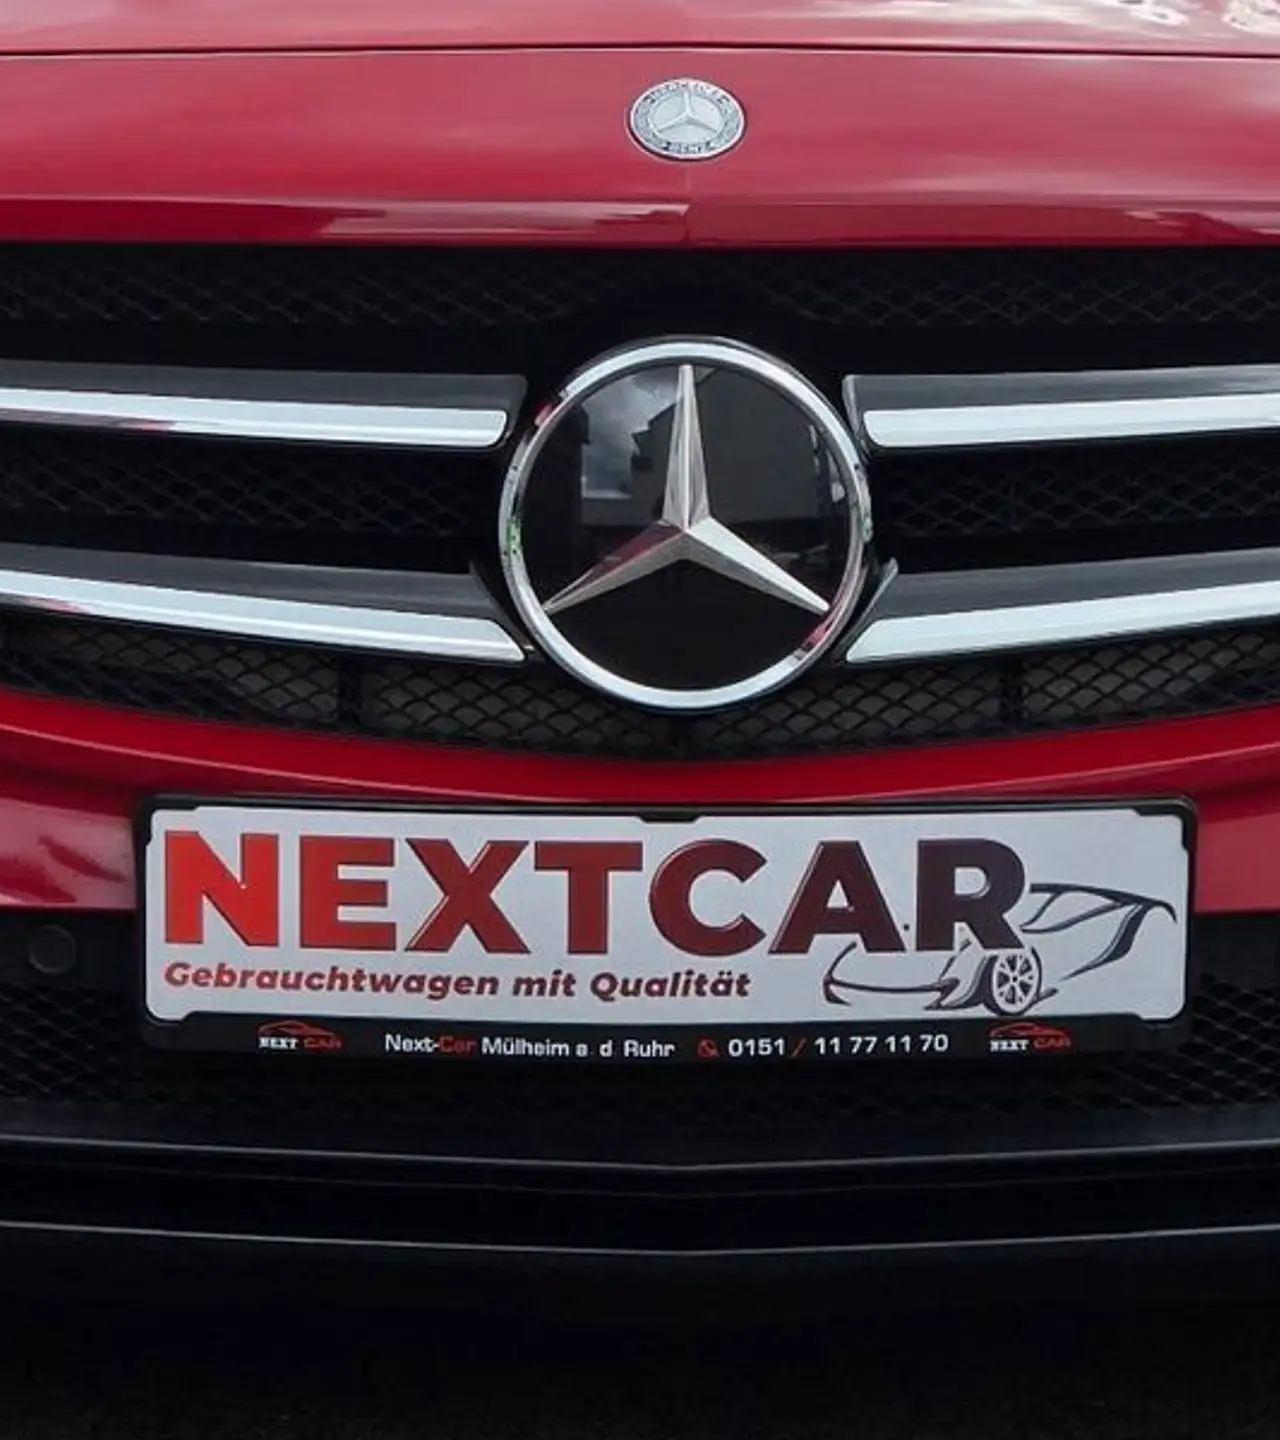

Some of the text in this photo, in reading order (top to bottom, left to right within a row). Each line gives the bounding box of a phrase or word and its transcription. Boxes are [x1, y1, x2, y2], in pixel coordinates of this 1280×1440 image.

[165, 830, 1024, 956] NEXTCAR
[165, 962, 751, 1002] Gebrauchtwagen mit Qualität
[259, 1037, 298, 1049] NEXT
[481, 1036, 569, 1057] Mülheim
[624, 1039, 675, 1057] Ruhr
[728, 1038, 785, 1056] 0151
[815, 1038, 840, 1054] 11
[849, 1037, 877, 1053] 77
[885, 1036, 911, 1052] 11
[921, 1034, 949, 1052] 70
[989, 1038, 1029, 1051] NEXT
